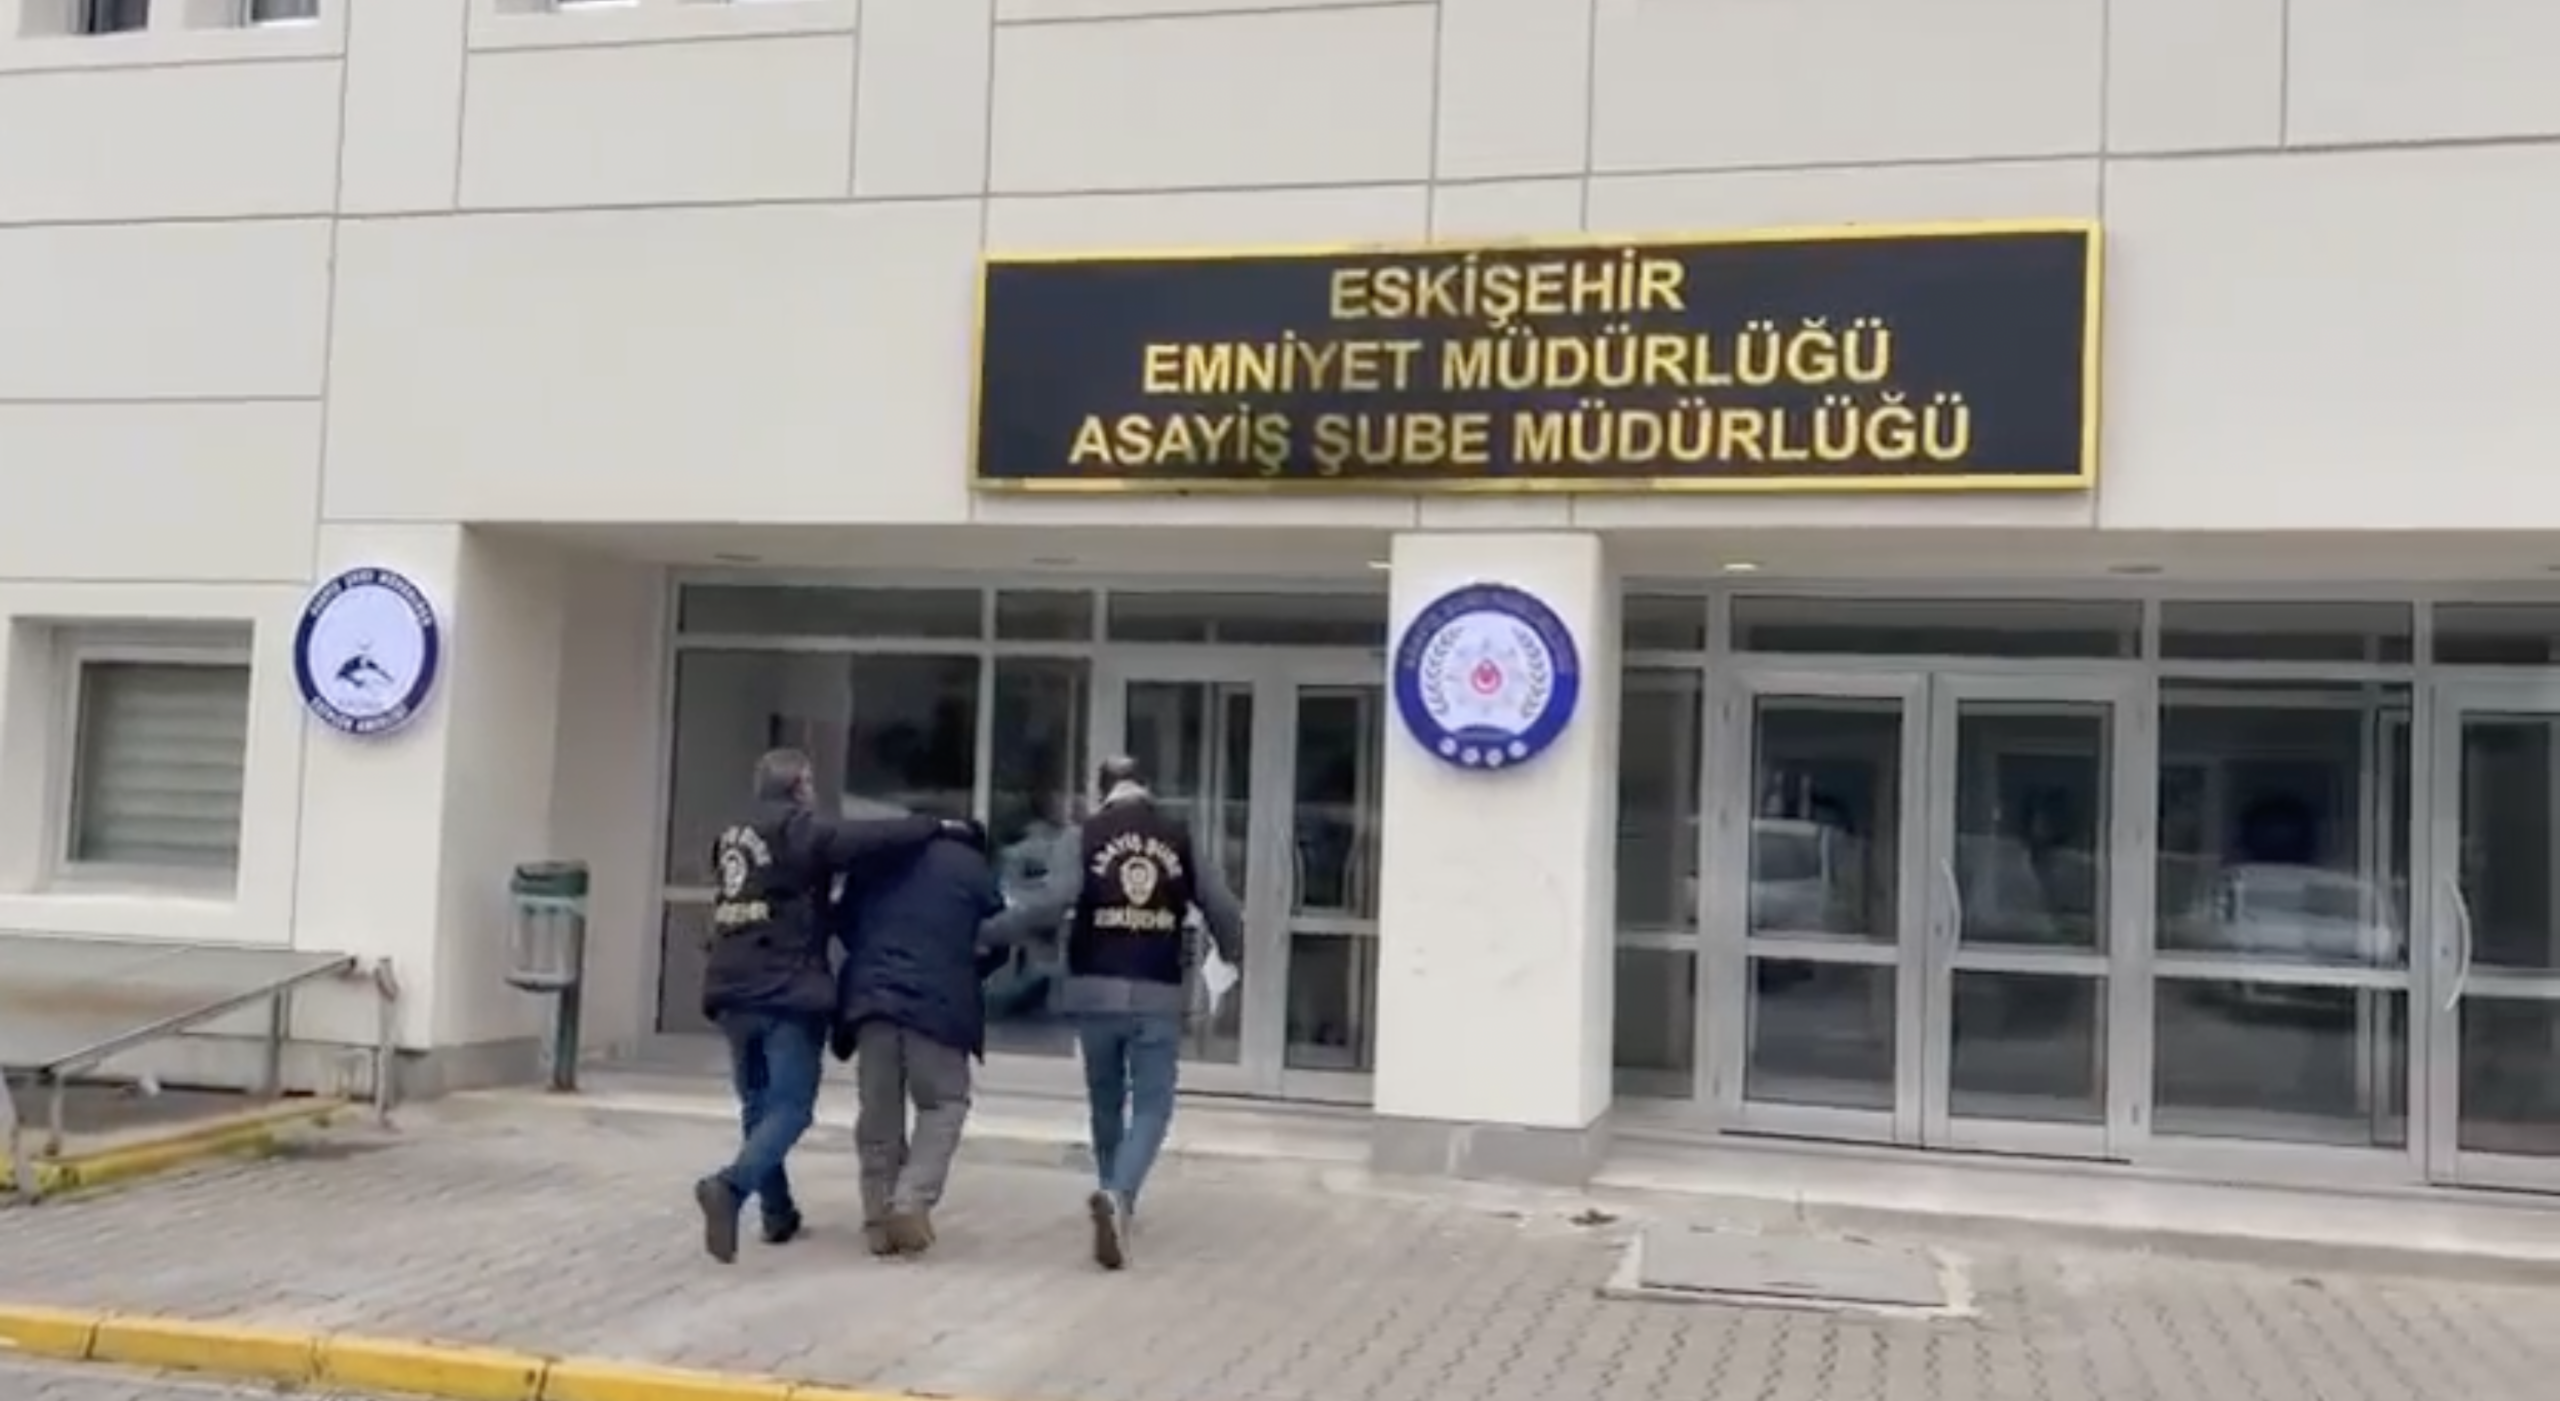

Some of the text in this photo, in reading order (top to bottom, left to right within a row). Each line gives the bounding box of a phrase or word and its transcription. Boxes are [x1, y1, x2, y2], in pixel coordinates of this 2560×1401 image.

[1330, 247, 1685, 328] ESKİŞEHİR
[1143, 316, 1891, 393] EMNİYET MÜDÜRLÜĞÜ
[1067, 391, 1971, 476] ASAYİŞ ŞUBE MÜDÜRLÜĞÜ
